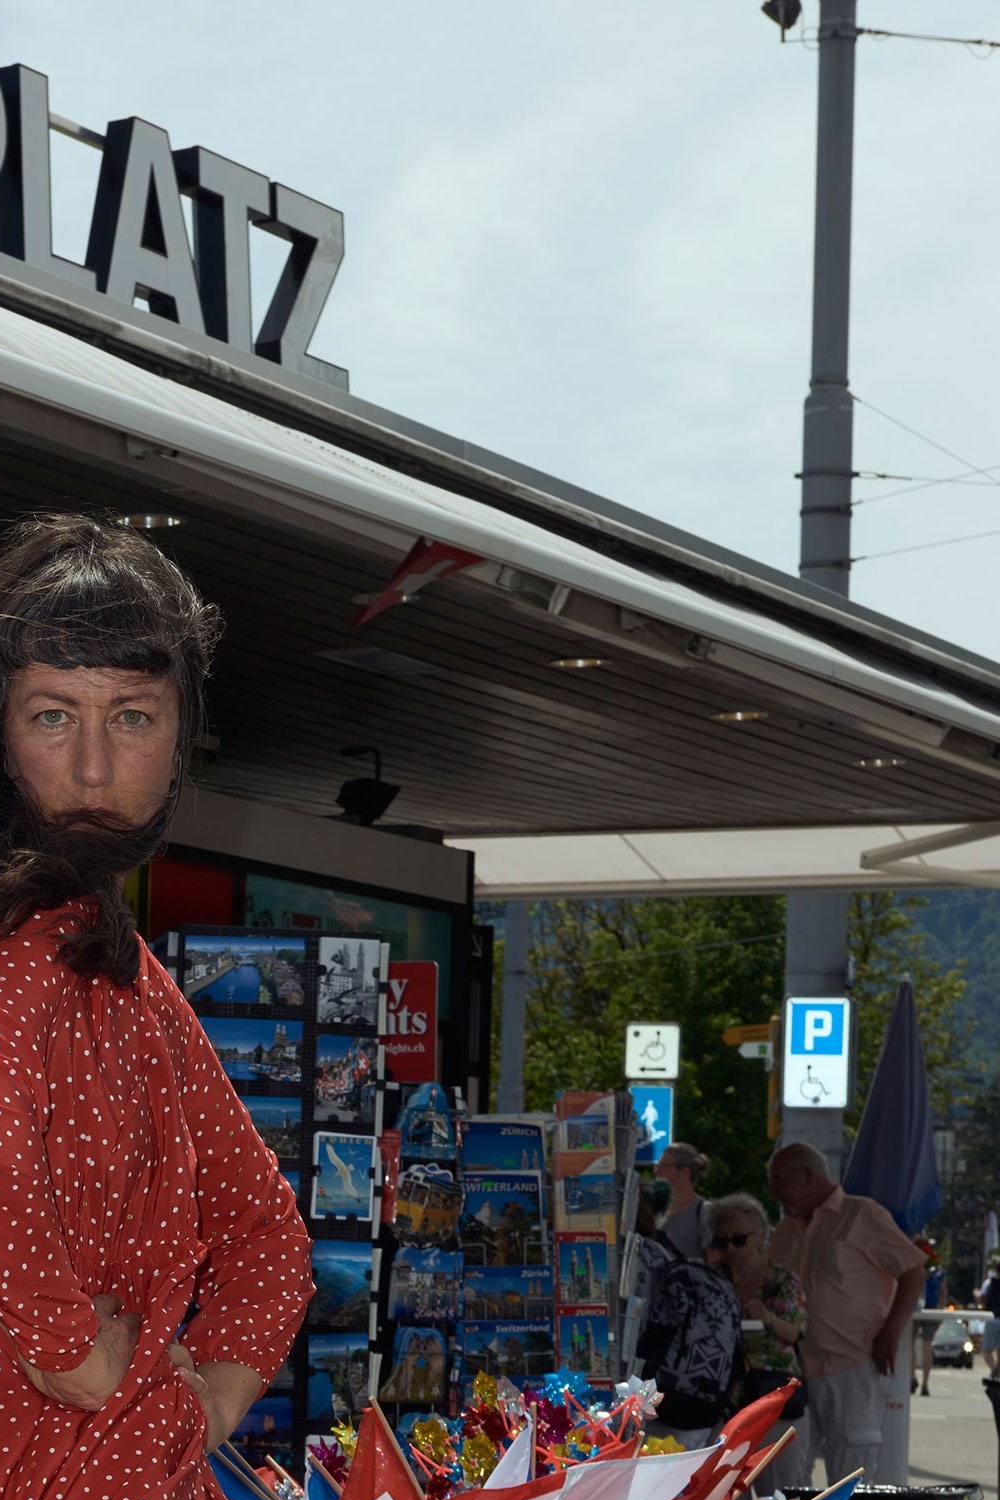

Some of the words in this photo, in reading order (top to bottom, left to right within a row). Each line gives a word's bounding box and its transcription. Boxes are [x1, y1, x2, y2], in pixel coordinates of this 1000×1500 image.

[804, 1010, 832, 1051] P
[500, 1126, 538, 1137] ZÜRICH
[521, 1270, 551, 1278] Zürich
[495, 1324, 550, 1333] Switzerland
